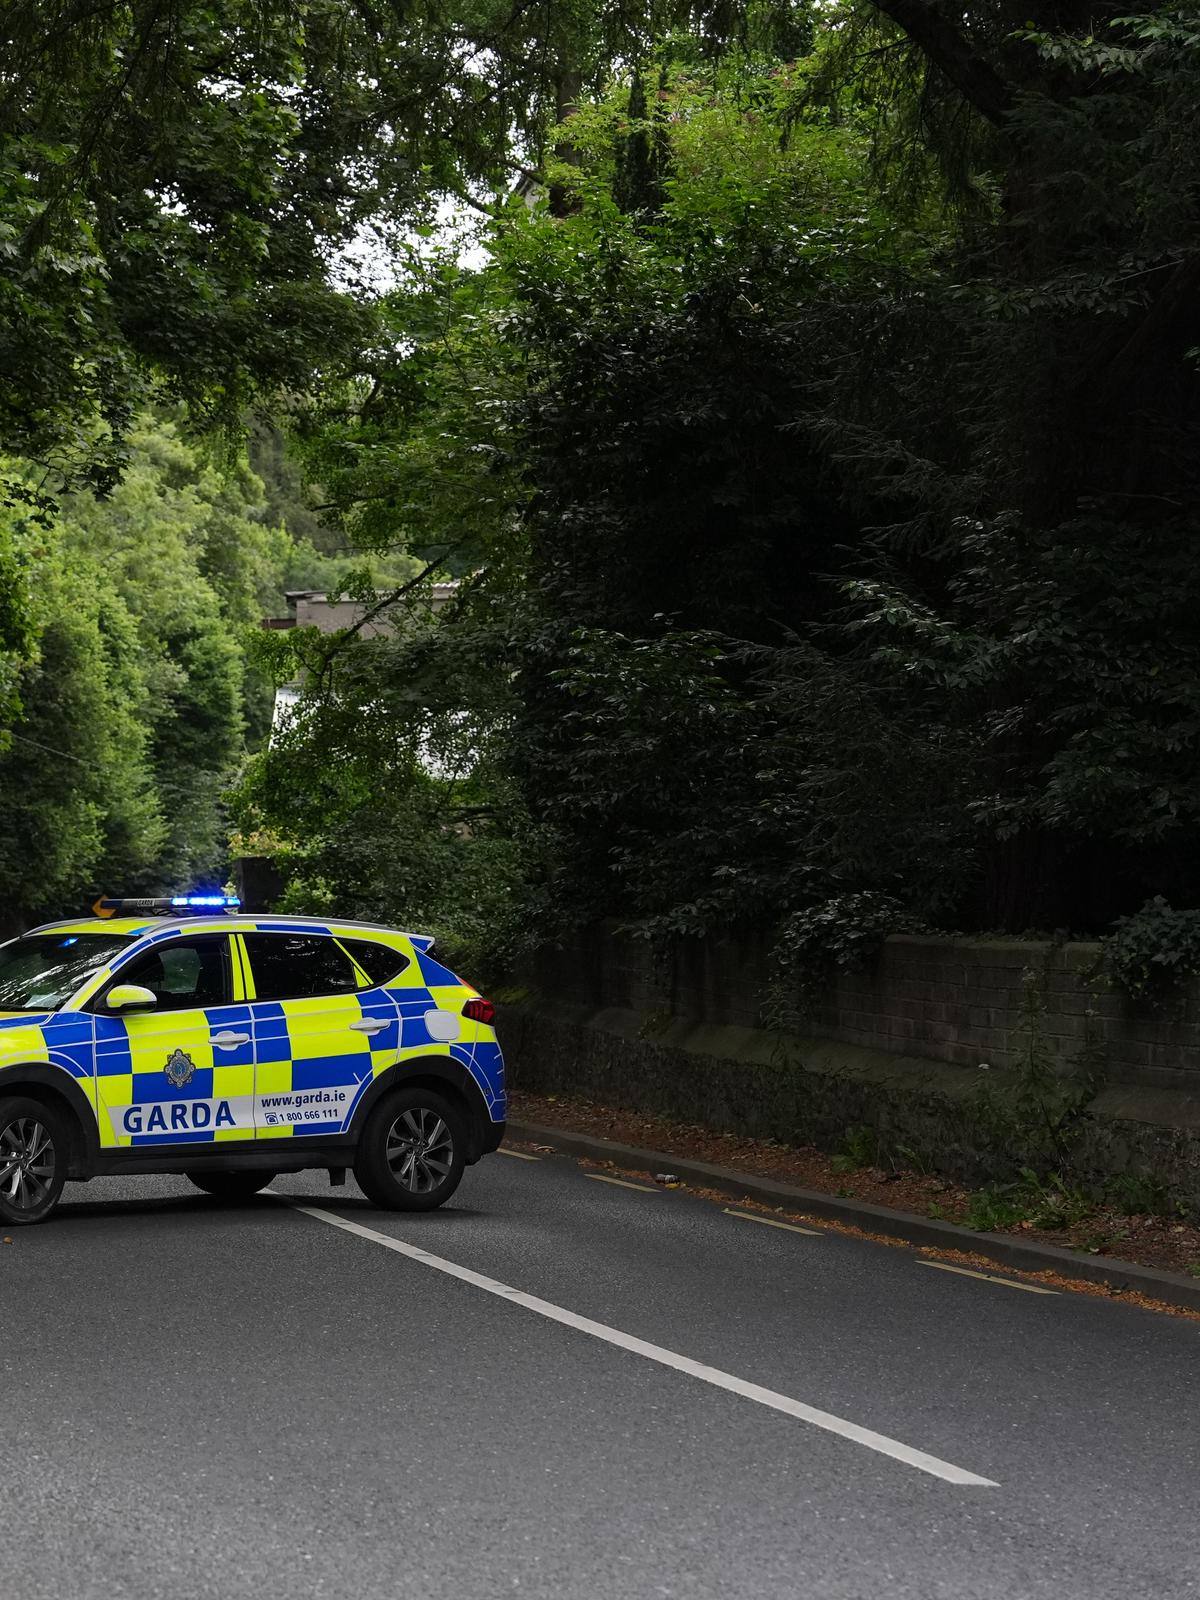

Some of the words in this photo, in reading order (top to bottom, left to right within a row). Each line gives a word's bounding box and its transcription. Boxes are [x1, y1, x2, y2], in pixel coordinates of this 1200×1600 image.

[261, 1090, 346, 1108] www.garda.ie
[123, 1101, 237, 1133] GARDA
[286, 1112, 303, 1121] 800
[304, 1110, 321, 1120] 666
[322, 1108, 339, 1119] 111
